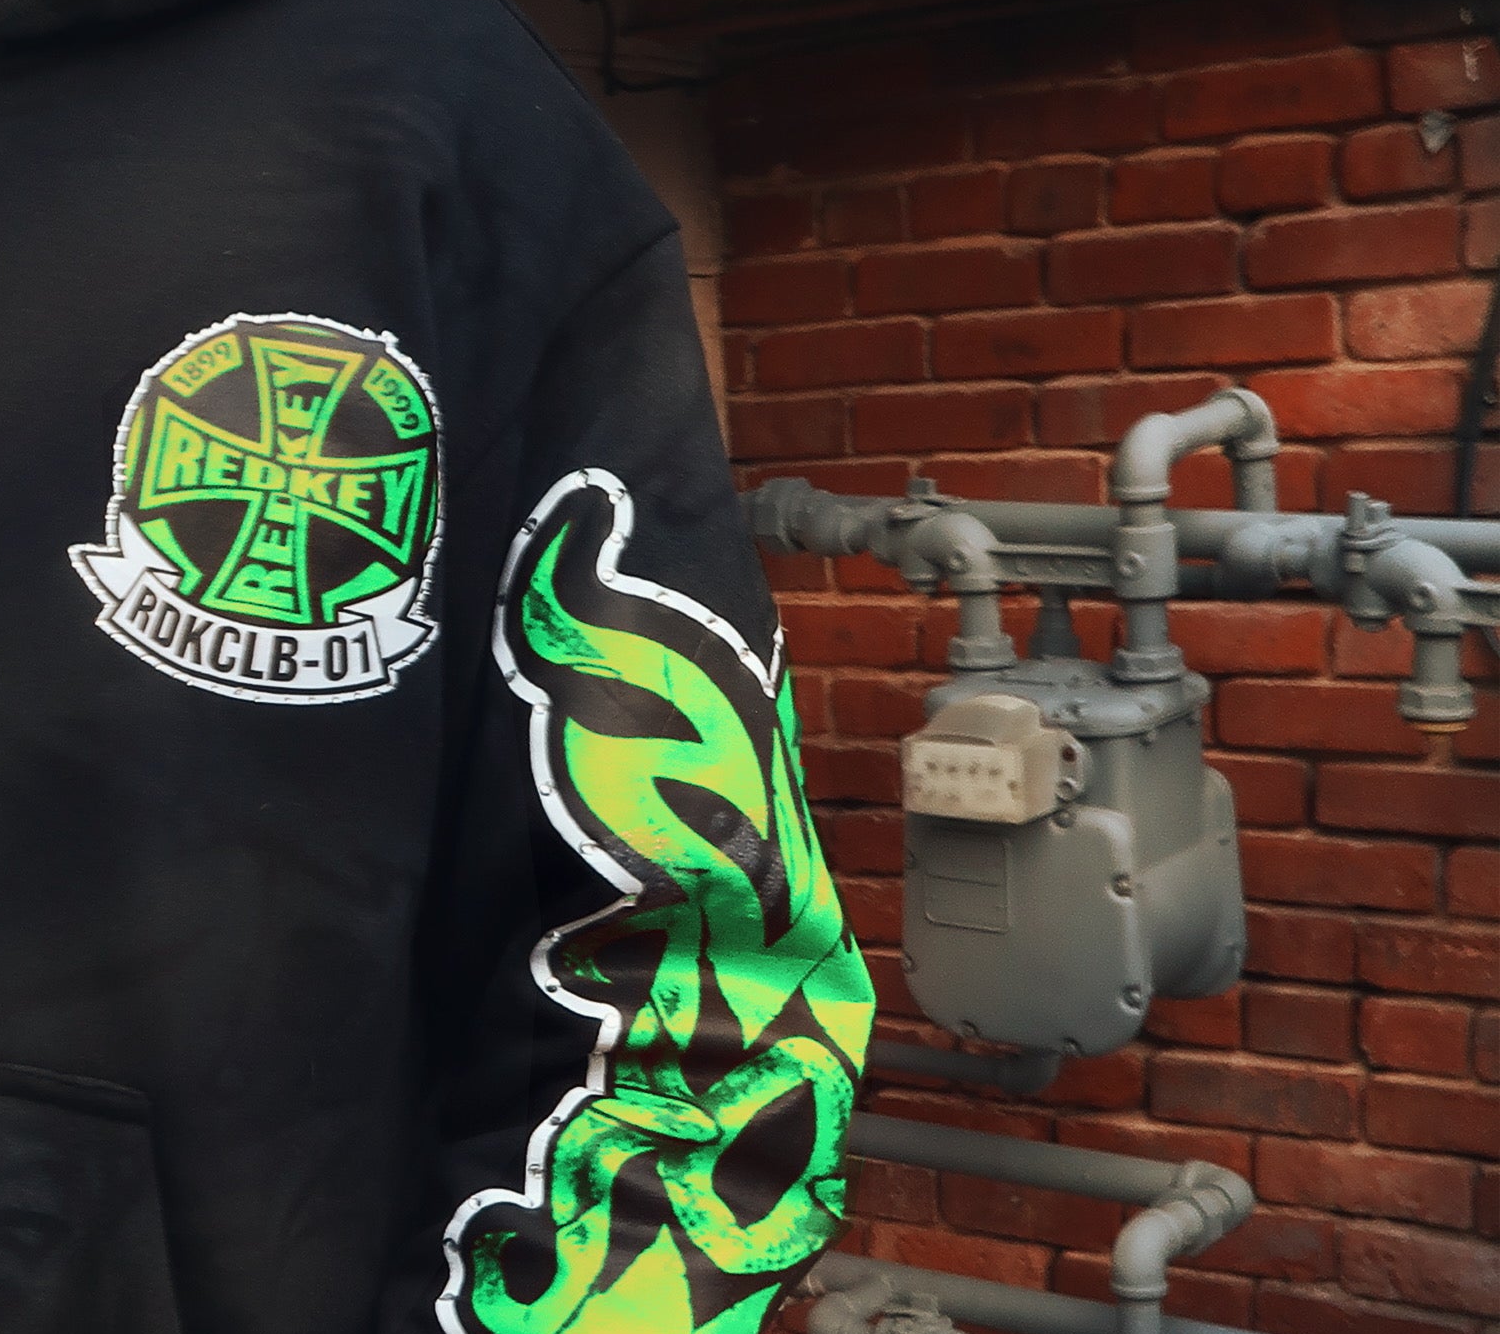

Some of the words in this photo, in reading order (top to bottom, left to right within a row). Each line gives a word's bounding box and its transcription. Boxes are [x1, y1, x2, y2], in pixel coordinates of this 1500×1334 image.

[172, 341, 231, 387] 1899
[369, 369, 419, 430] 1999
[157, 430, 418, 535] REDKEY
[128, 585, 371, 682] RDKCLB-01
